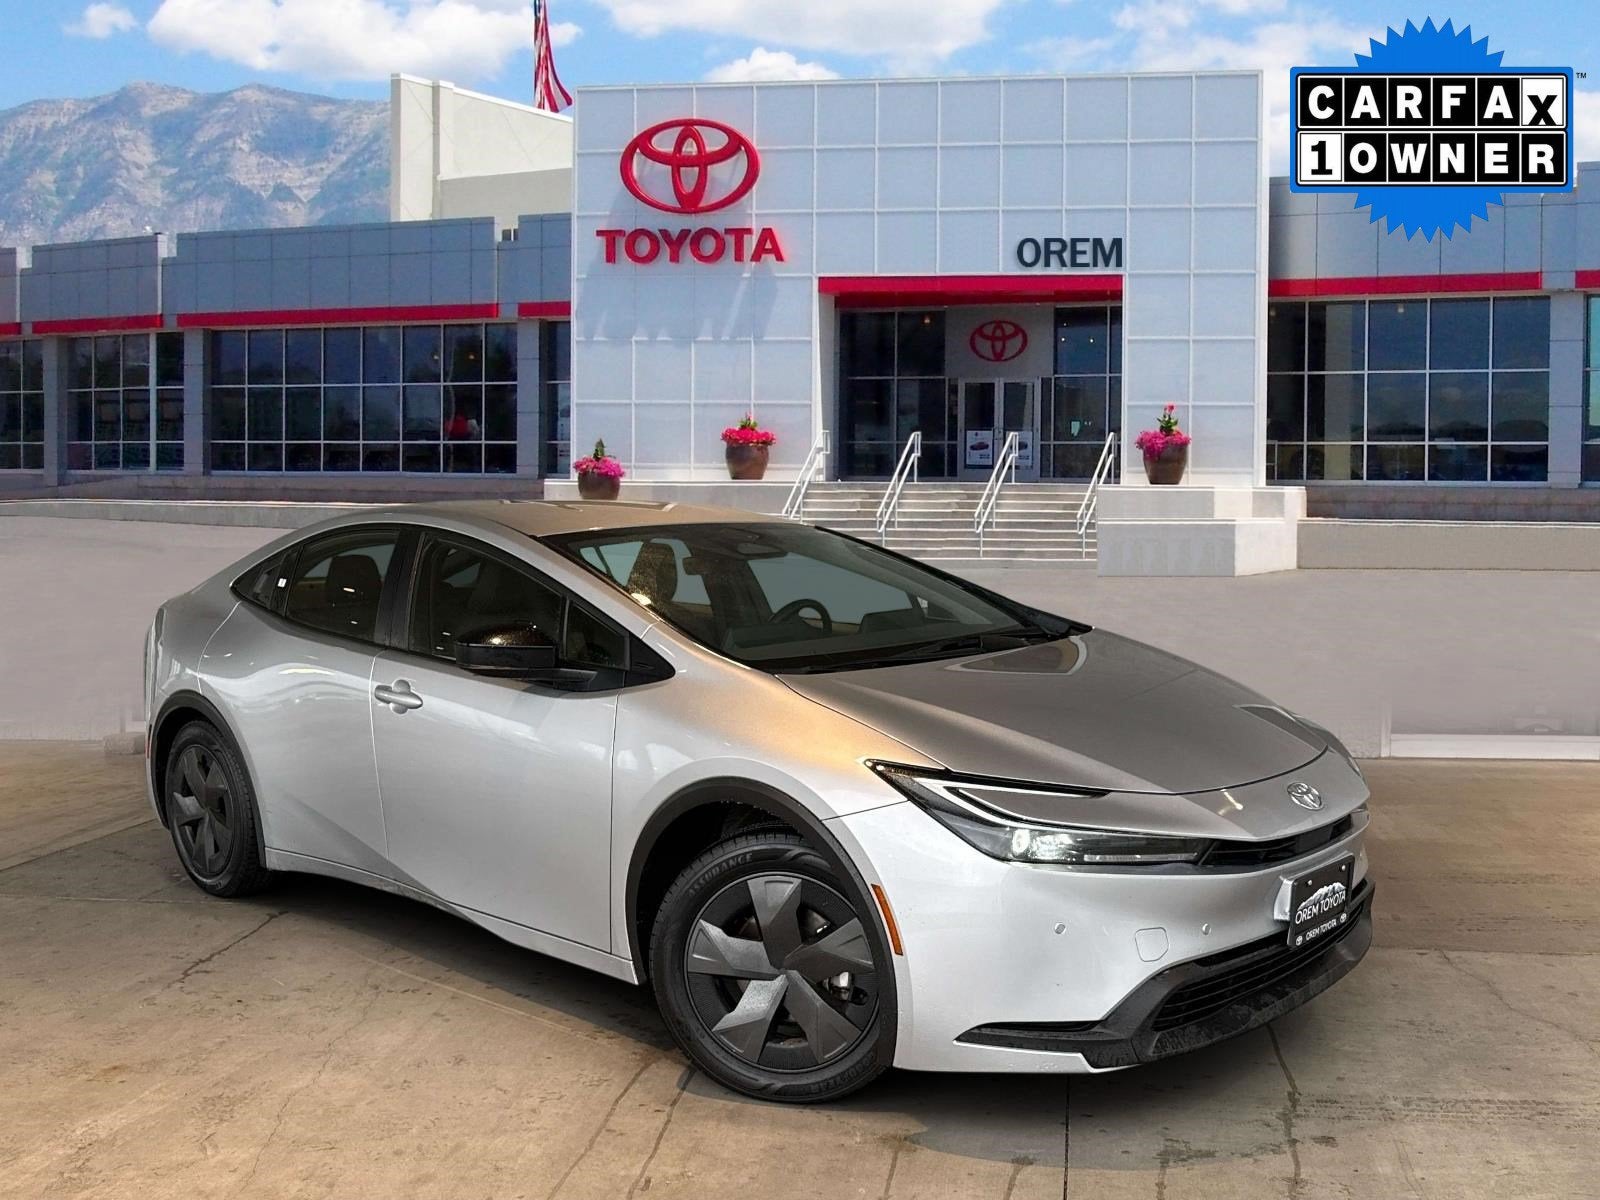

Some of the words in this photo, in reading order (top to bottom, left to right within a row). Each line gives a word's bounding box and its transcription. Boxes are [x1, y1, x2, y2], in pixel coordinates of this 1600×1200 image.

[596, 227, 784, 264] TOYOTA
[1017, 237, 1122, 268] OREM
[1295, 902, 1319, 924] OREM
[1320, 890, 1346, 914] TOYOTA
[1306, 928, 1320, 940] OREM
[1320, 919, 1337, 932] TOYOTA
